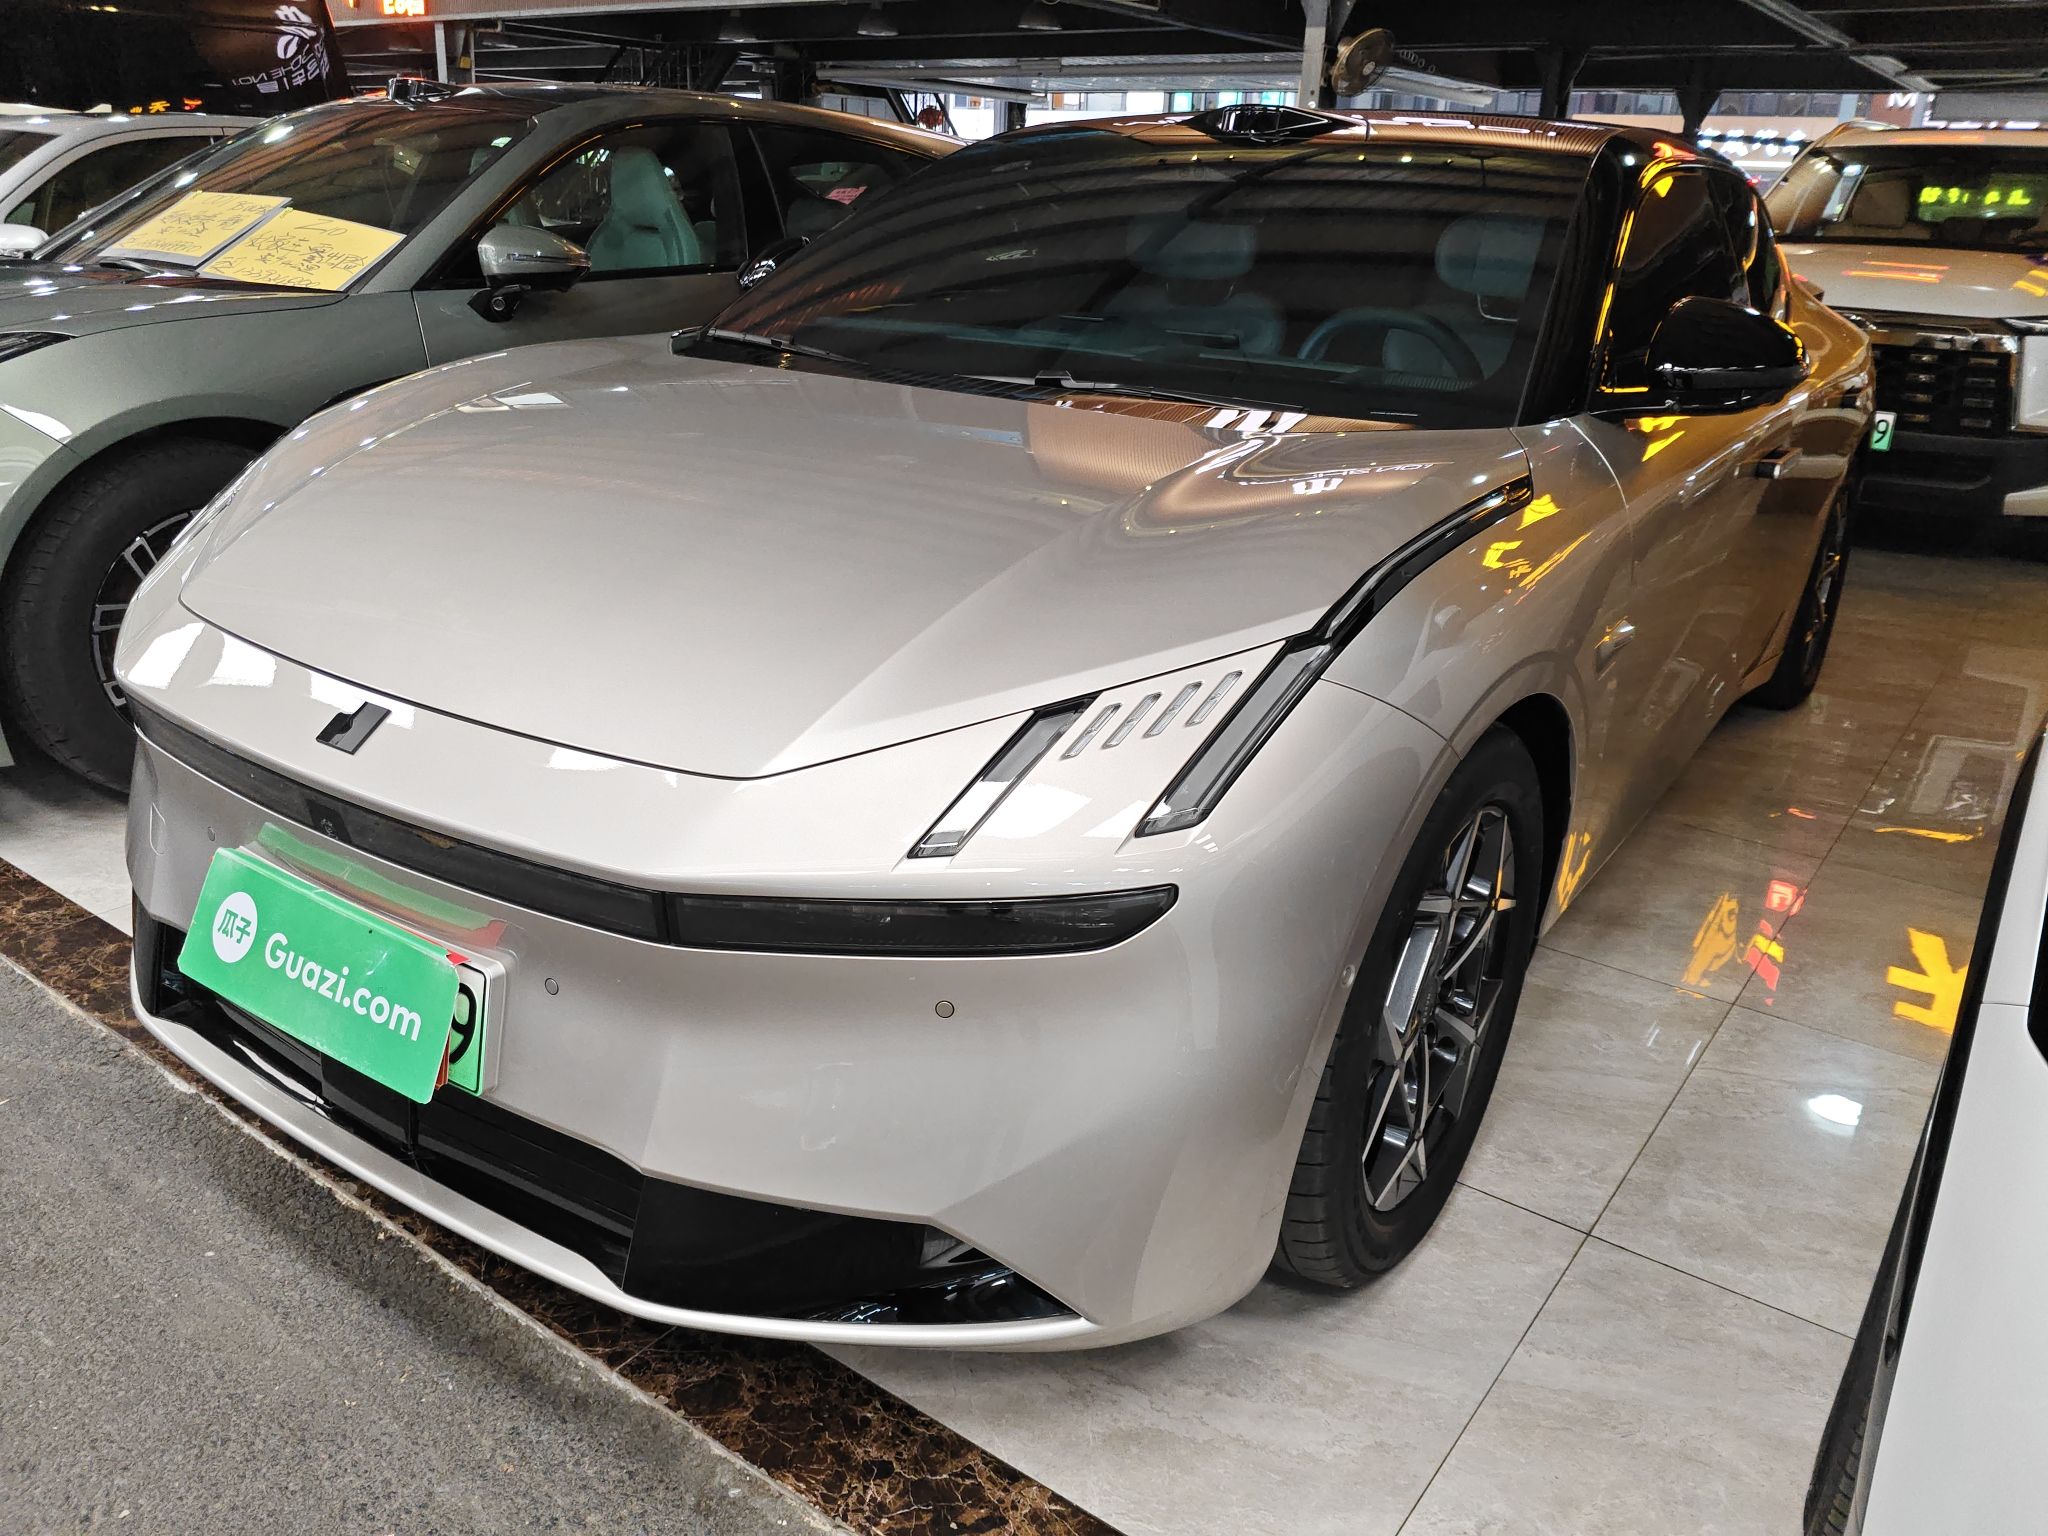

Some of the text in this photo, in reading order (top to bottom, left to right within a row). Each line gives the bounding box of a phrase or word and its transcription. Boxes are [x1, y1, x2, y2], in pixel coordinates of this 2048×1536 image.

[1874, 419, 1890, 444] 9
[216, 908, 253, 945] 瓜子
[264, 932, 423, 1042] Guazi.com
